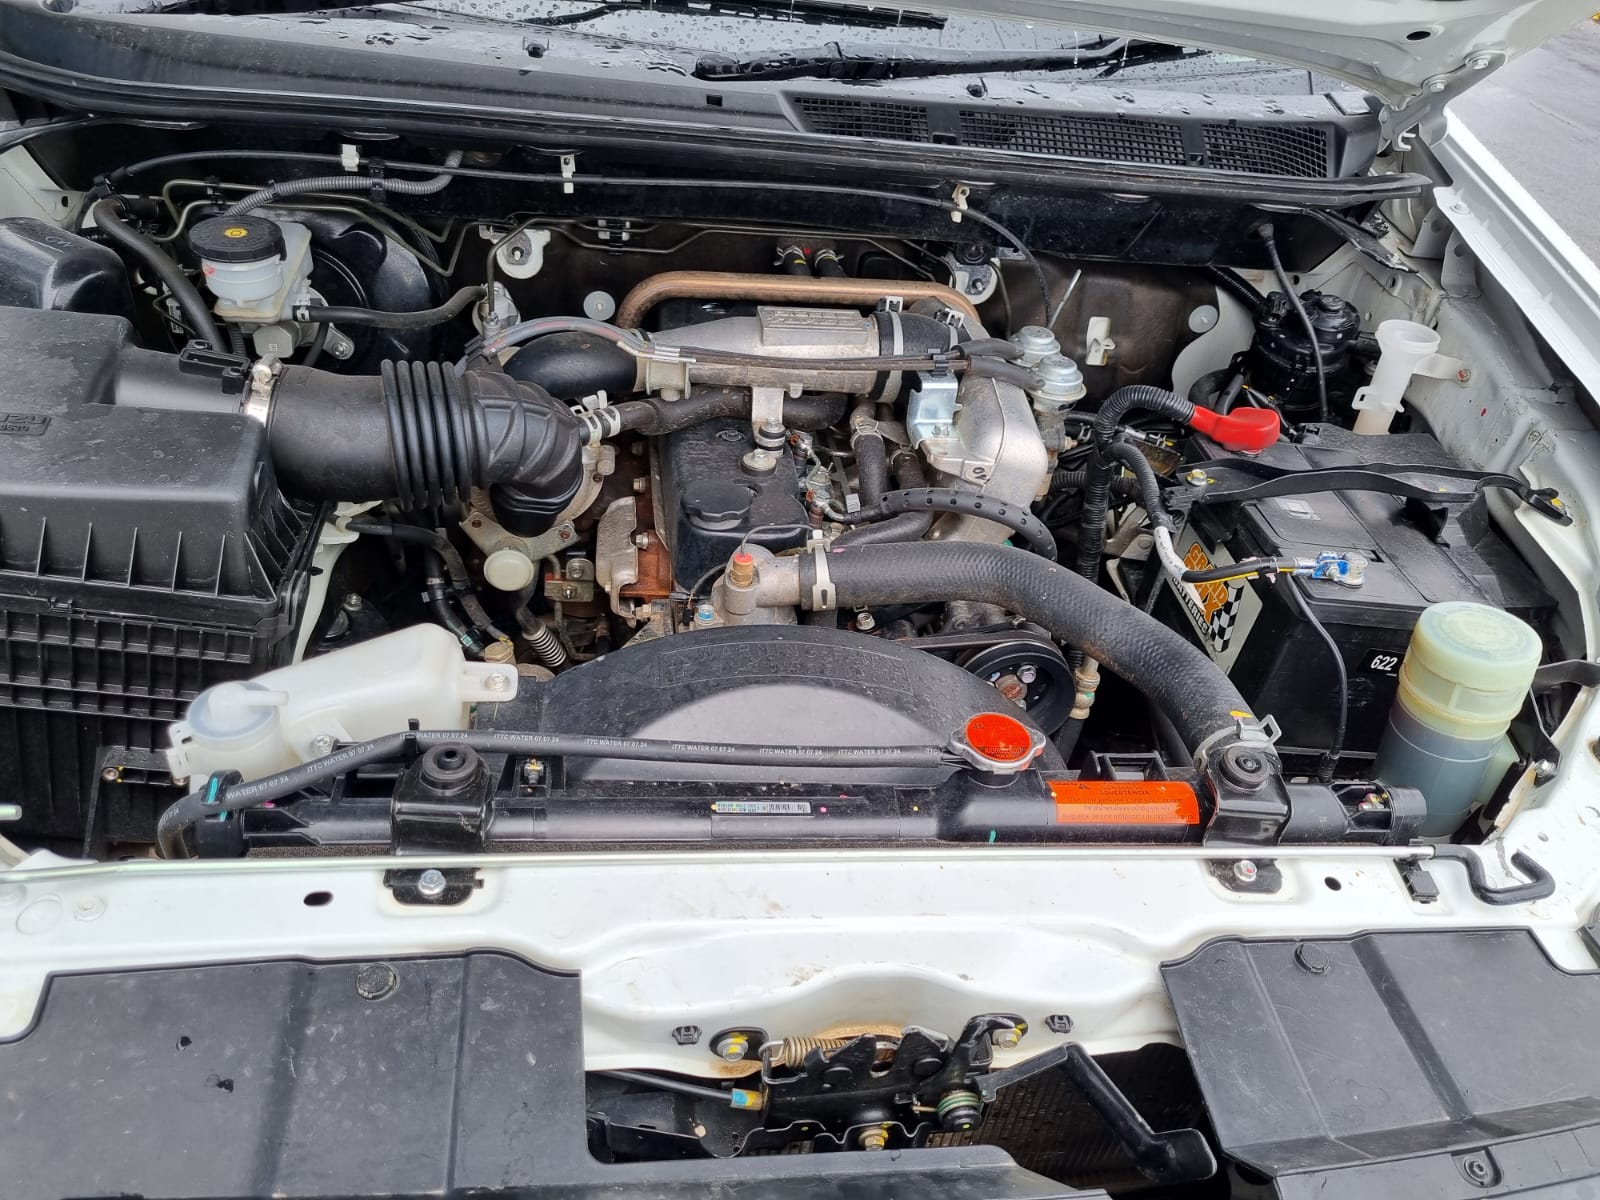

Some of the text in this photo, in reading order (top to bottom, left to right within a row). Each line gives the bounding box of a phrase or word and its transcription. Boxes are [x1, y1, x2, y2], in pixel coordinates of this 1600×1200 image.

[1190, 542, 1229, 606] GRND
[1370, 654, 1399, 671] 622
[509, 734, 534, 742] WATER
[599, 739, 622, 747] WATER
[686, 744, 710, 752] WATER
[322, 752, 349, 767] WATER
[225, 785, 259, 799] WATER
